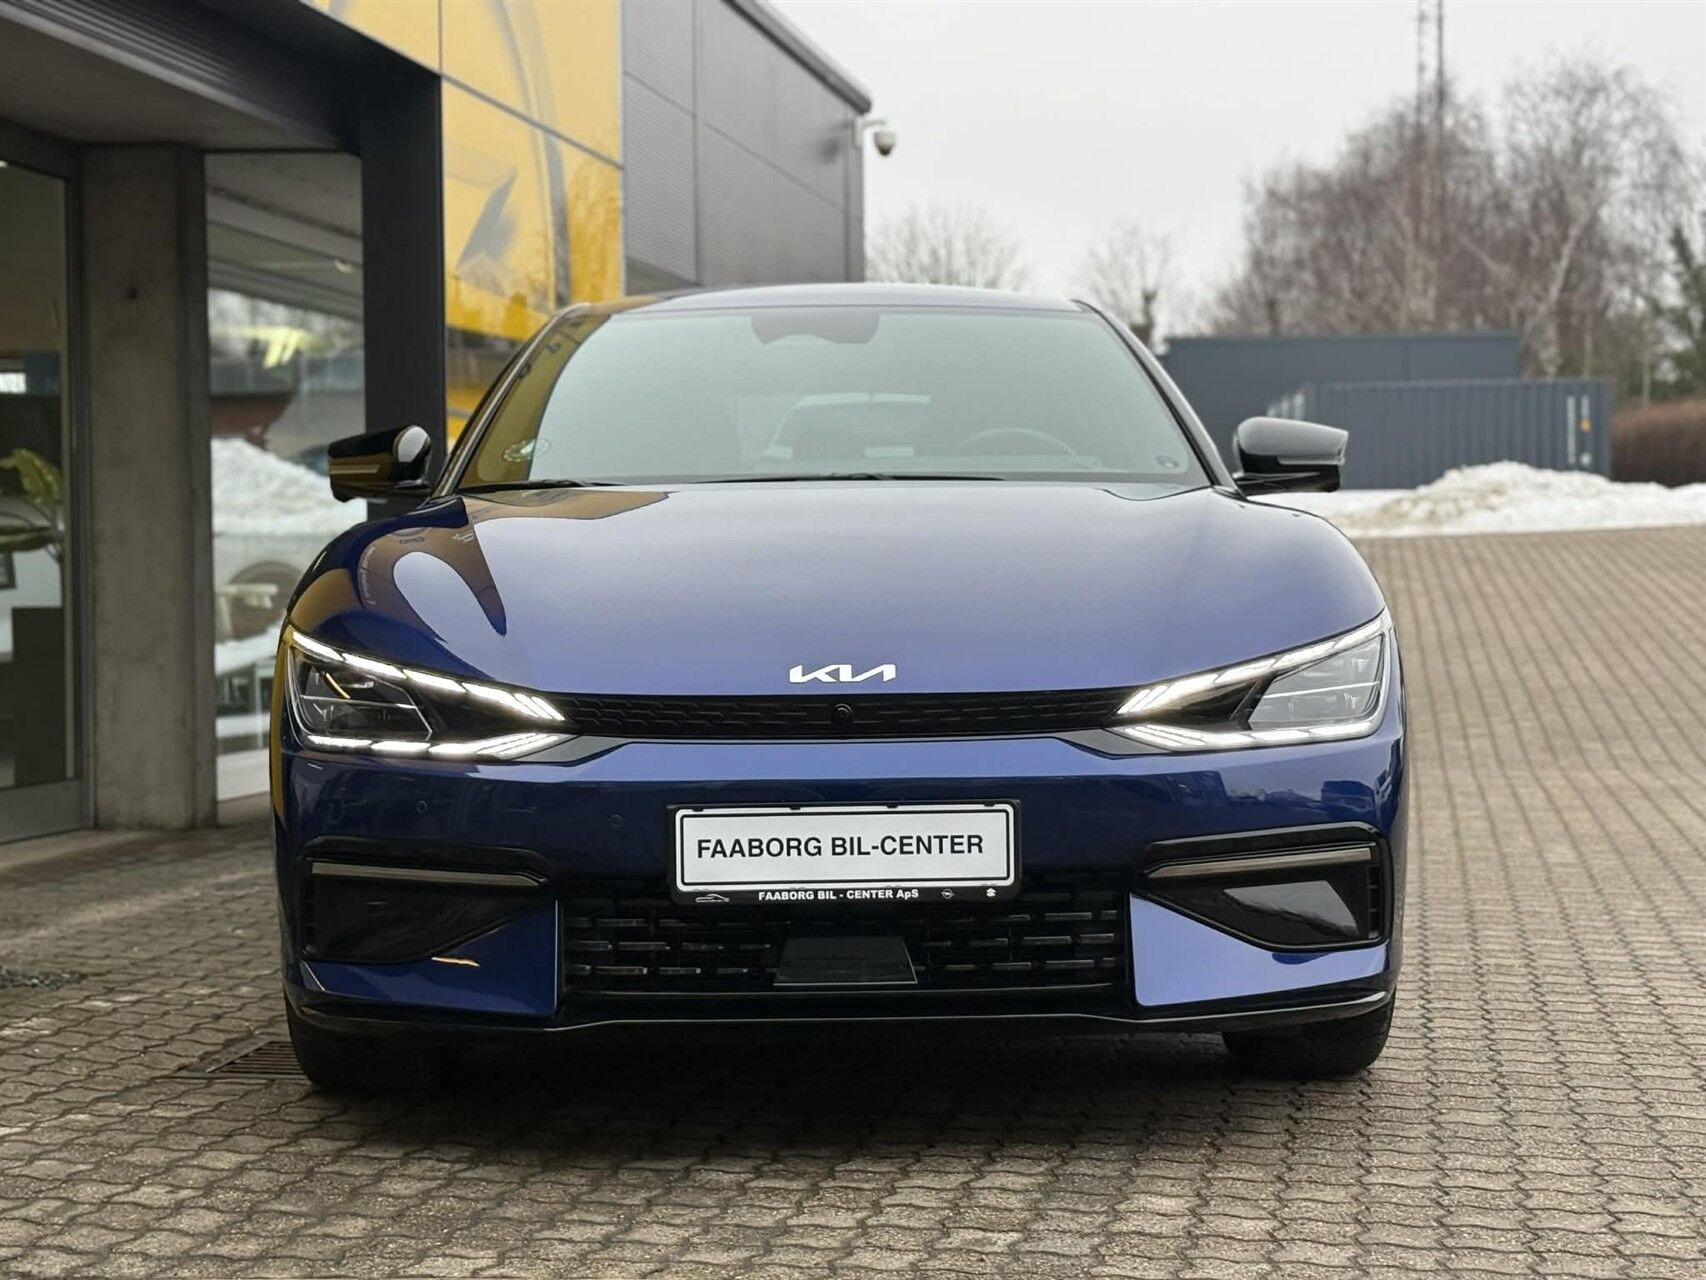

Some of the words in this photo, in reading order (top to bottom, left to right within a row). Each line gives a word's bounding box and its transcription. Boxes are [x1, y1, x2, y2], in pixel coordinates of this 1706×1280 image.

[789, 663, 897, 683] KIA
[697, 837, 822, 859] FAABORG
[831, 834, 984, 856] BIL-CENTER
[758, 891, 815, 901] FAABORG
[817, 890, 837, 900] BIL
[846, 889, 894, 899] CENTER
[896, 889, 919, 900] ApS
